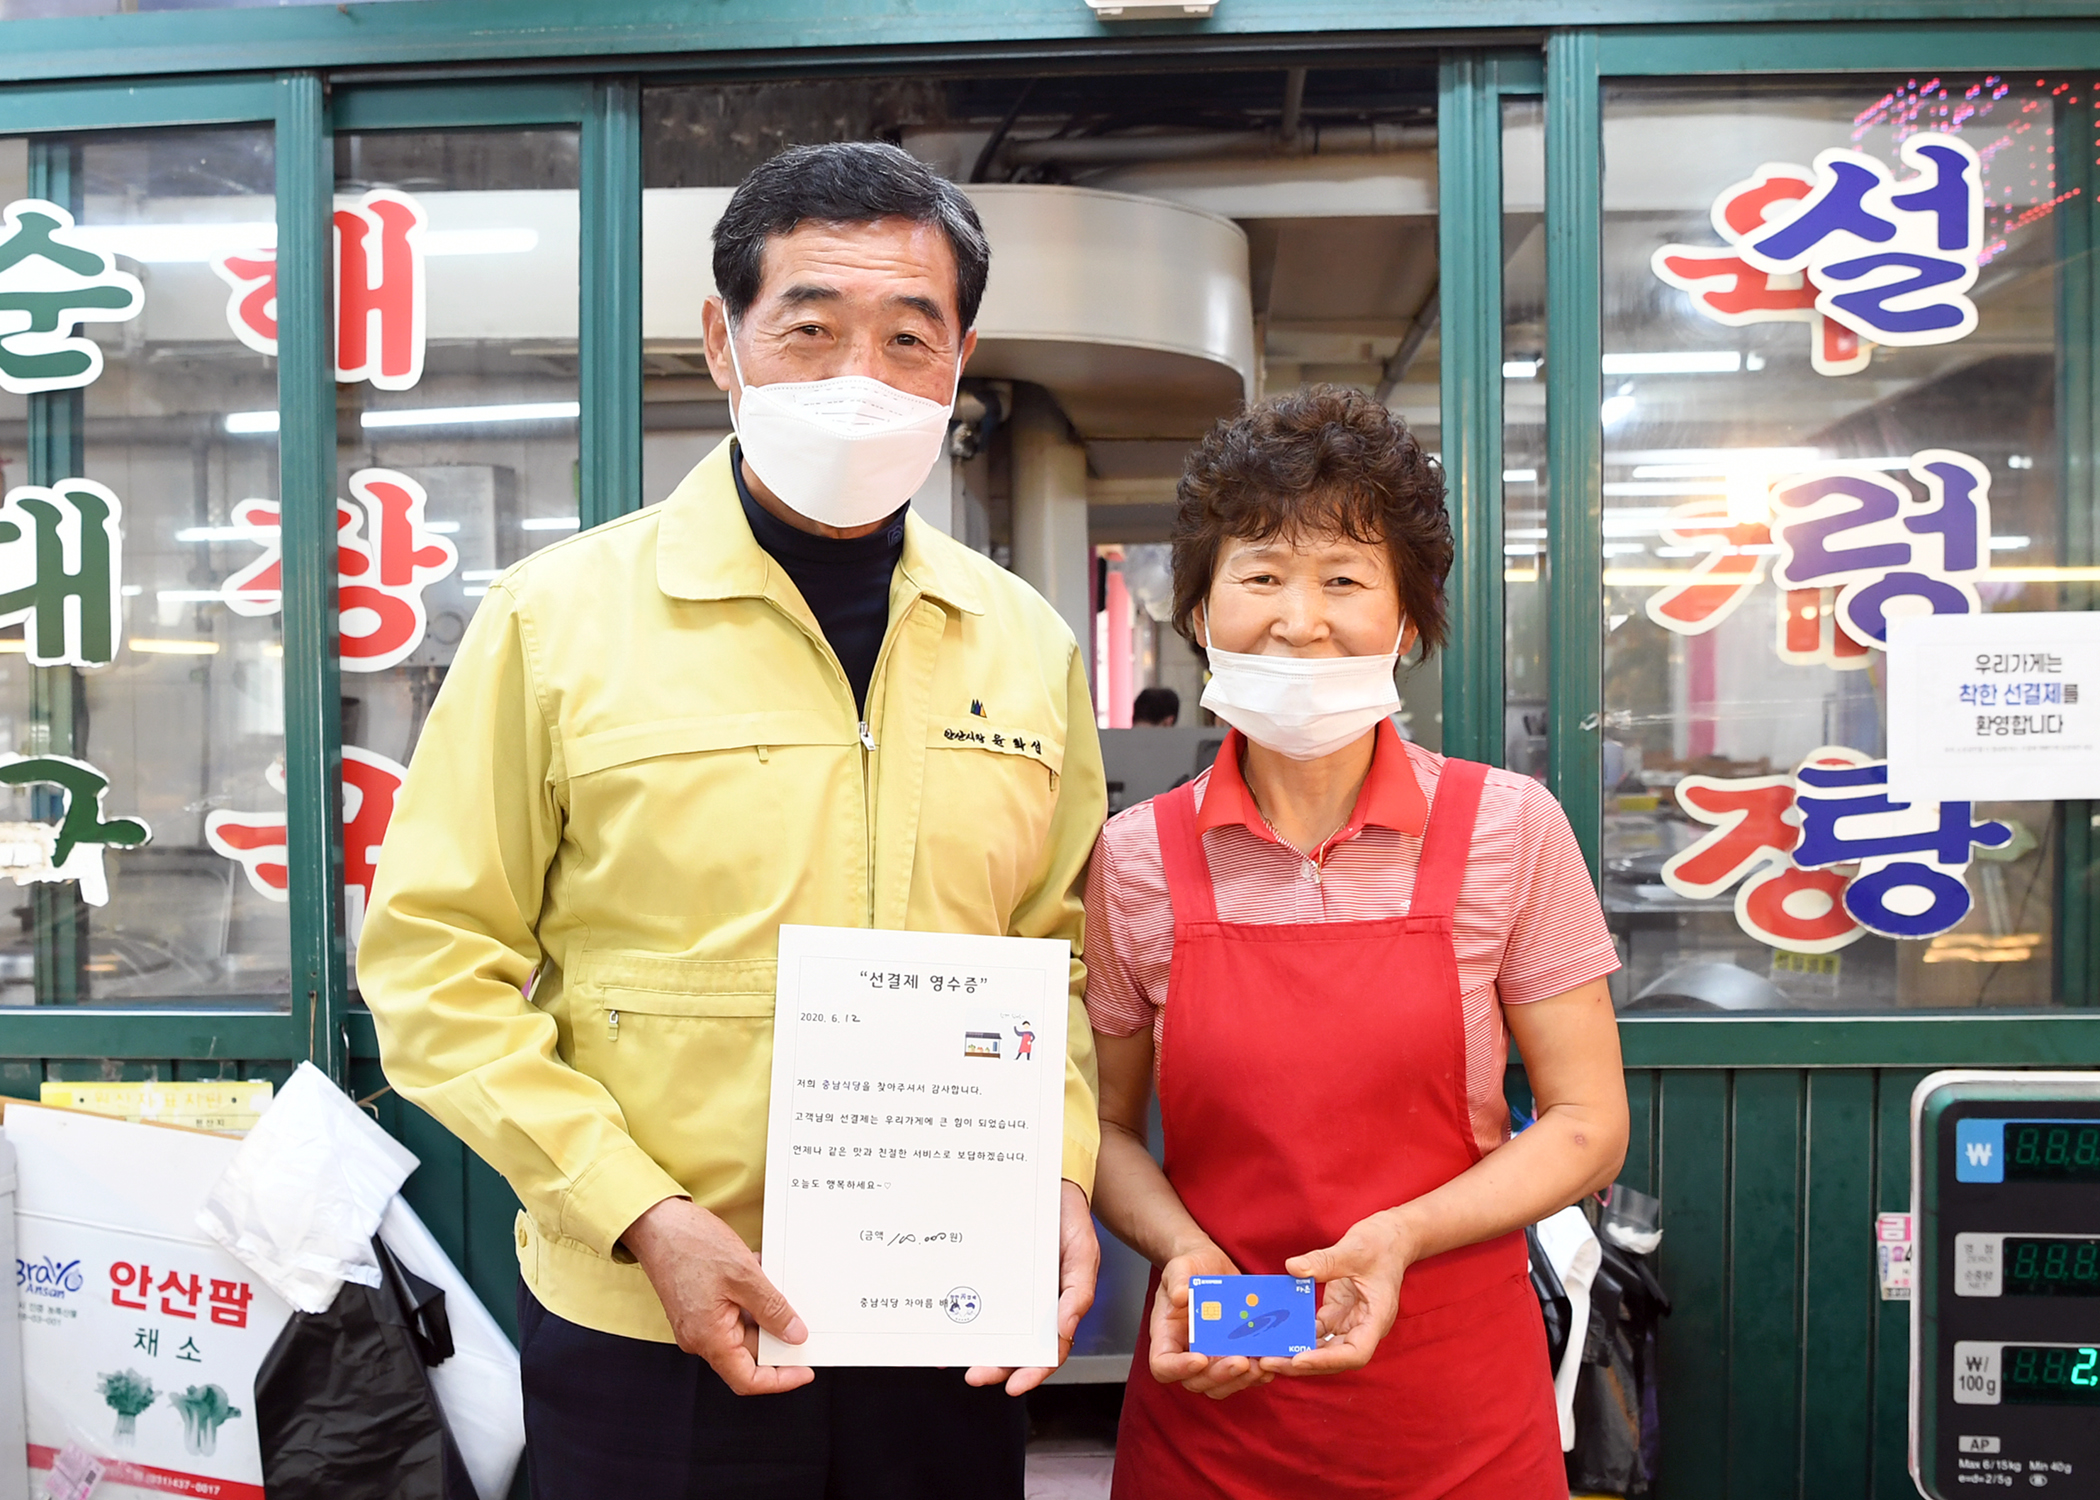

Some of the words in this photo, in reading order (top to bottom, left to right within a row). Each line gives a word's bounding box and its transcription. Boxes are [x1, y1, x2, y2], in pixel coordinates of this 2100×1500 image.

[1750, 140, 2014, 938] 설렁탕
[1975, 653, 2063, 675] 우리가게는
[1959, 683, 1997, 706] 착한
[2004, 682, 2079, 706] 선결제를
[1976, 714, 2063, 736] 환영합니다
[796, 1078, 816, 1089] 저희
[821, 1079, 871, 1092] 충남식당을
[877, 1081, 925, 1093] 찾아주셔서
[931, 1084, 982, 1096] 감사합니다.
[794, 1111, 834, 1123] 고객님의
[839, 1113, 879, 1125] 선결제는
[885, 1115, 934, 1126] 우리가게에
[939, 1117, 948, 1128] 큰
[954, 1117, 973, 1129] 힘이
[978, 1118, 1029, 1130] 되었습니다.
[792, 1144, 822, 1156] 언제나
[828, 1146, 847, 1157] 같은
[852, 1147, 873, 1158] 맛과
[878, 1147, 908, 1159] 친절한
[912, 1149, 951, 1159] 서비스로
[957, 1150, 1028, 1162] 보답하겠습니다.
[791, 1178, 820, 1190] 오늘도
[859, 1229, 884, 1242] (금액
[26, 1283, 66, 1299] Ansan
[109, 1260, 253, 1329] 안산팜
[860, 1297, 899, 1309] 충남식당
[1970, 1438, 1990, 1451] AP
[1958, 1458, 1981, 1470] Max
[2028, 1460, 2049, 1472] Min
